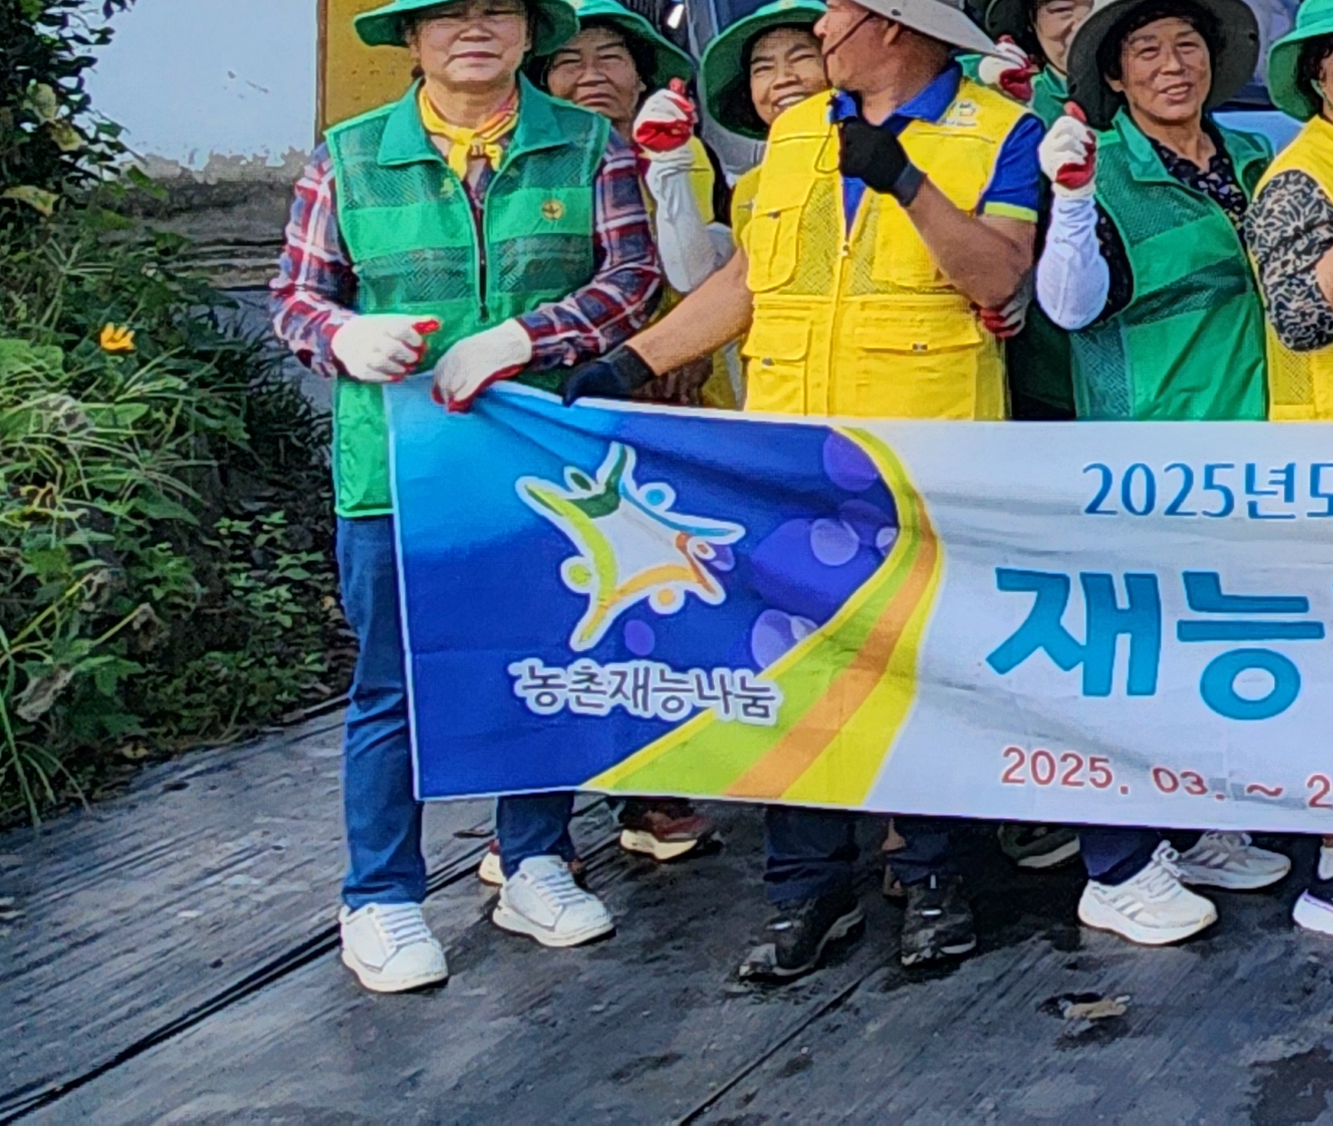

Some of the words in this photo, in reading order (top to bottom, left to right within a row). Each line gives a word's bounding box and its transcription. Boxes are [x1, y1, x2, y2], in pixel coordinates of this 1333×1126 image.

[516, 661, 778, 720] 농촌재능나눔
[1002, 747, 1131, 795] 2025.
[1152, 766, 1225, 800] 03.
